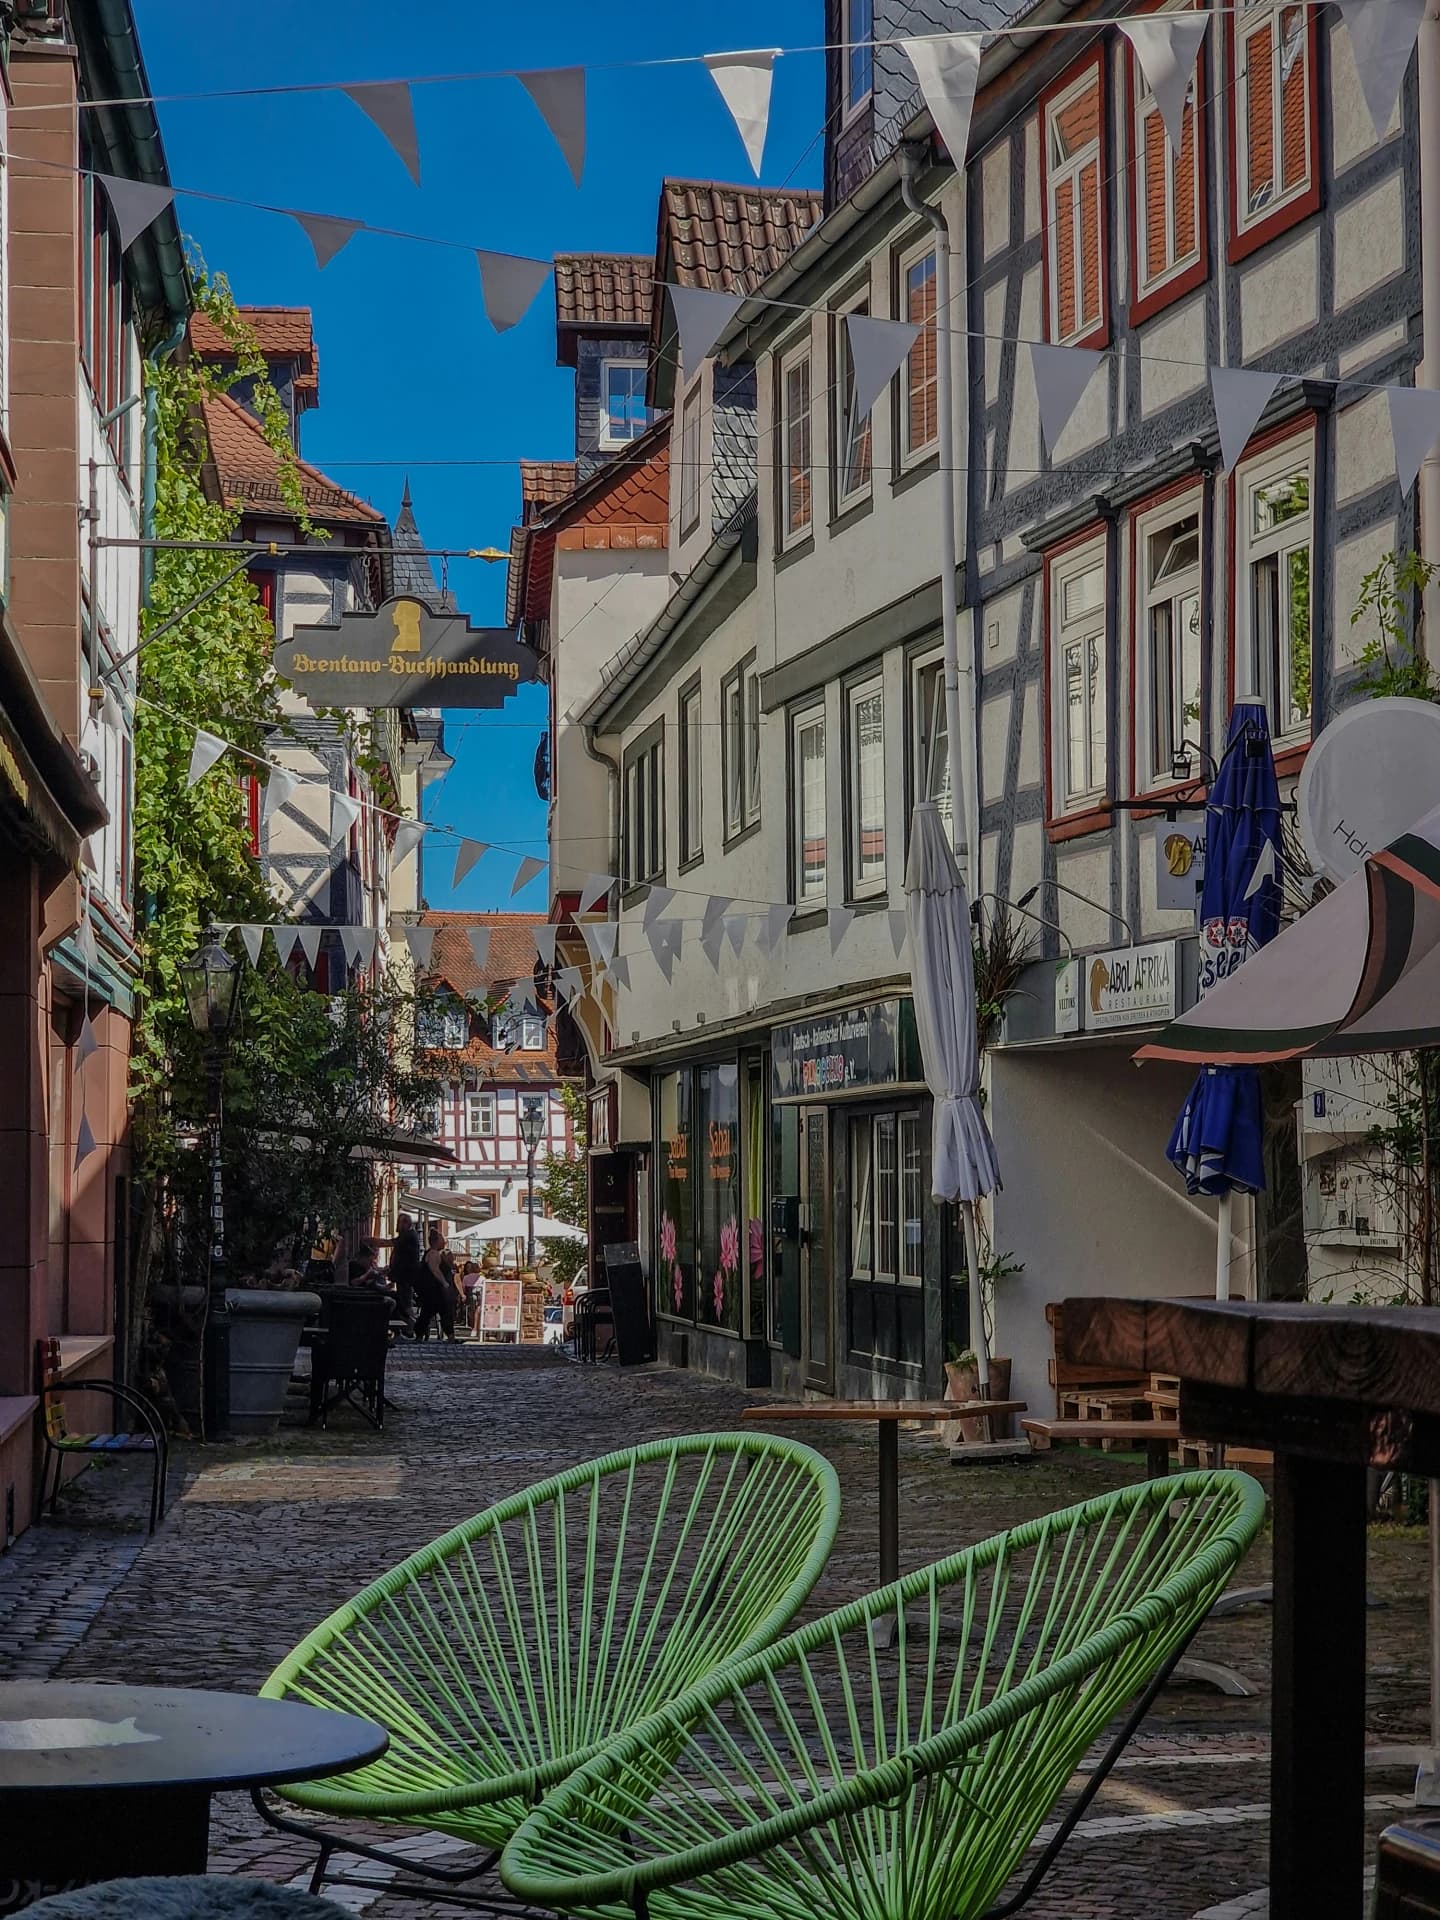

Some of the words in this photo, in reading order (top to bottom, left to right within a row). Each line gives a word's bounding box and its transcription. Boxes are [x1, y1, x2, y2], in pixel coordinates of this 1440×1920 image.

[292, 652, 520, 681] Brentano-Buchhandlung
[1109, 956, 1132, 995] ABOL
[1134, 951, 1170, 992] AFRIKA
[1108, 992, 1170, 1010] RESTAURANT
